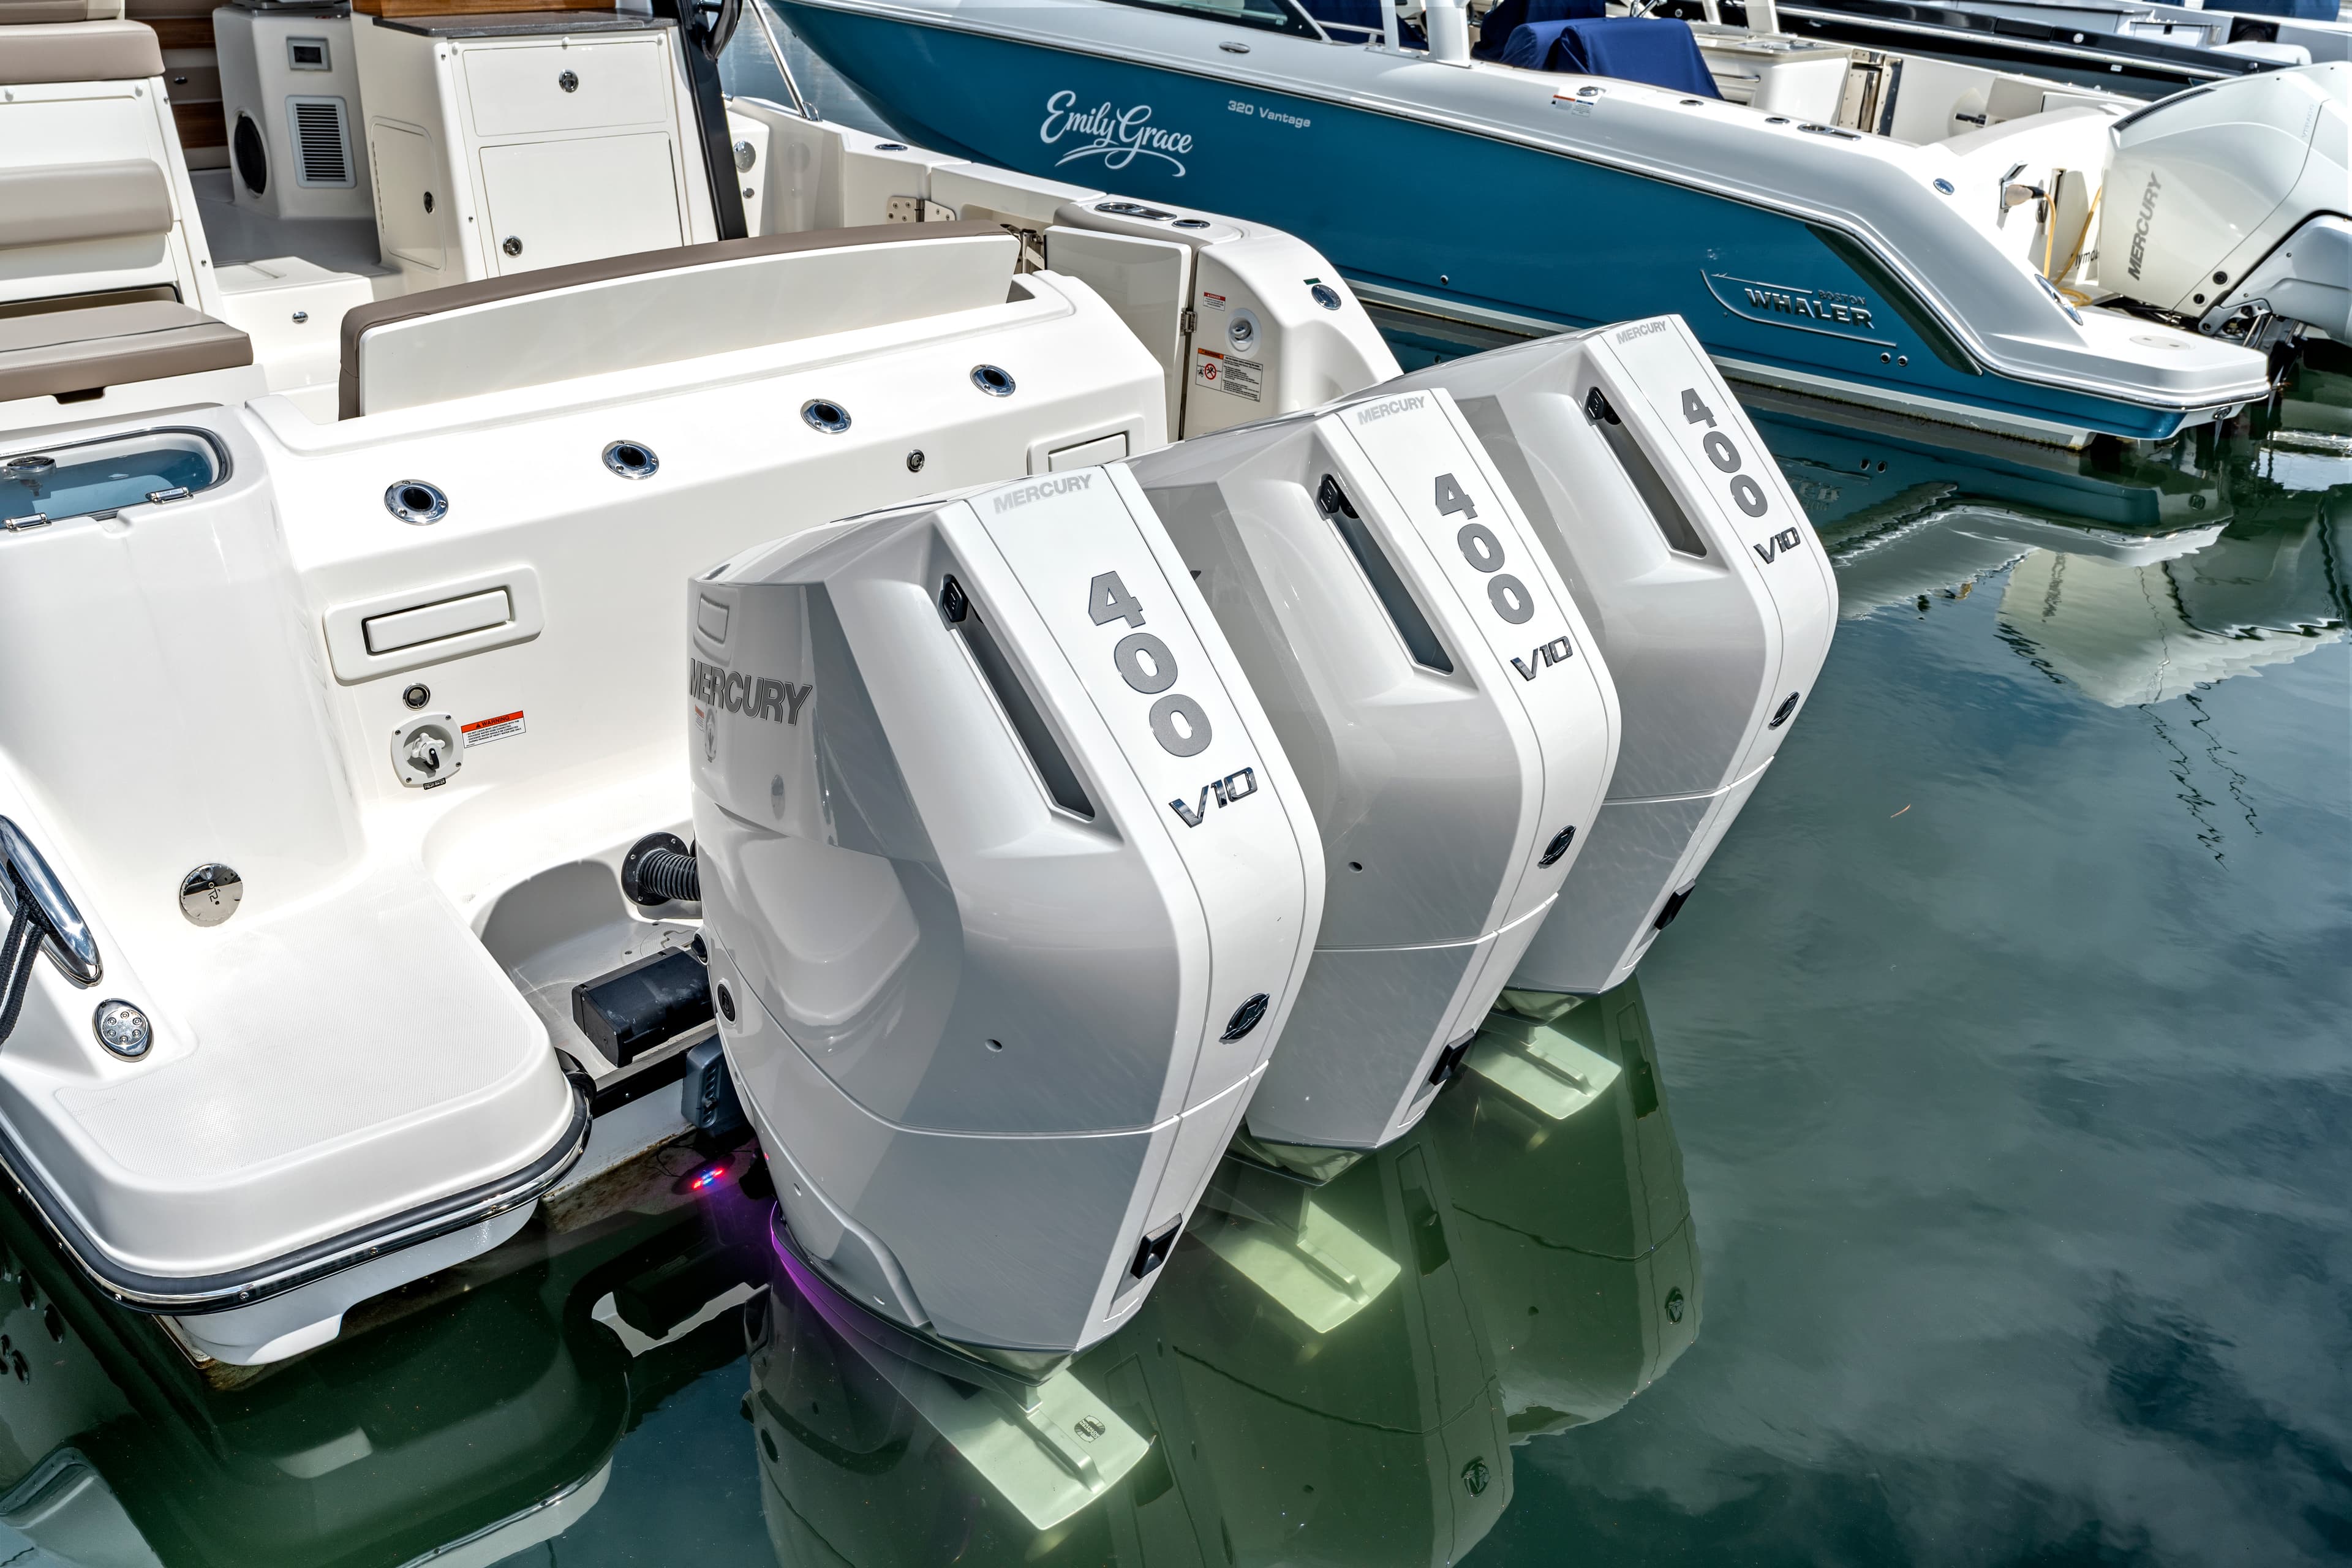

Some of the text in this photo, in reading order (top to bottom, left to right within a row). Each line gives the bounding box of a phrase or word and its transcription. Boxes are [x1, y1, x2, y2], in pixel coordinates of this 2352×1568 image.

[1040, 90, 1193, 169] Emily Grace
[1227, 100, 1311, 128] 320 Vantage
[2128, 170, 2162, 281] MERCURY
[1744, 287, 1875, 330] WHALER
[1818, 289, 1866, 304] BOSTON
[1616, 320, 1666, 344] MERCURY
[1357, 396, 1425, 425] MERCURY
[1681, 388, 1768, 518] 400
[993, 473, 1091, 514] MERCURY
[1435, 473, 1535, 625] 400
[1753, 527, 1801, 564] V10
[1088, 571, 1212, 758] 400
[1510, 636, 1574, 681] V10
[689, 657, 813, 726] MERCURY
[482, 715, 510, 727] WARNING
[1168, 767, 1258, 828] V10
[1079, 1421, 1098, 1439] COUNTER
[1082, 1419, 1100, 1437] ROTATION
